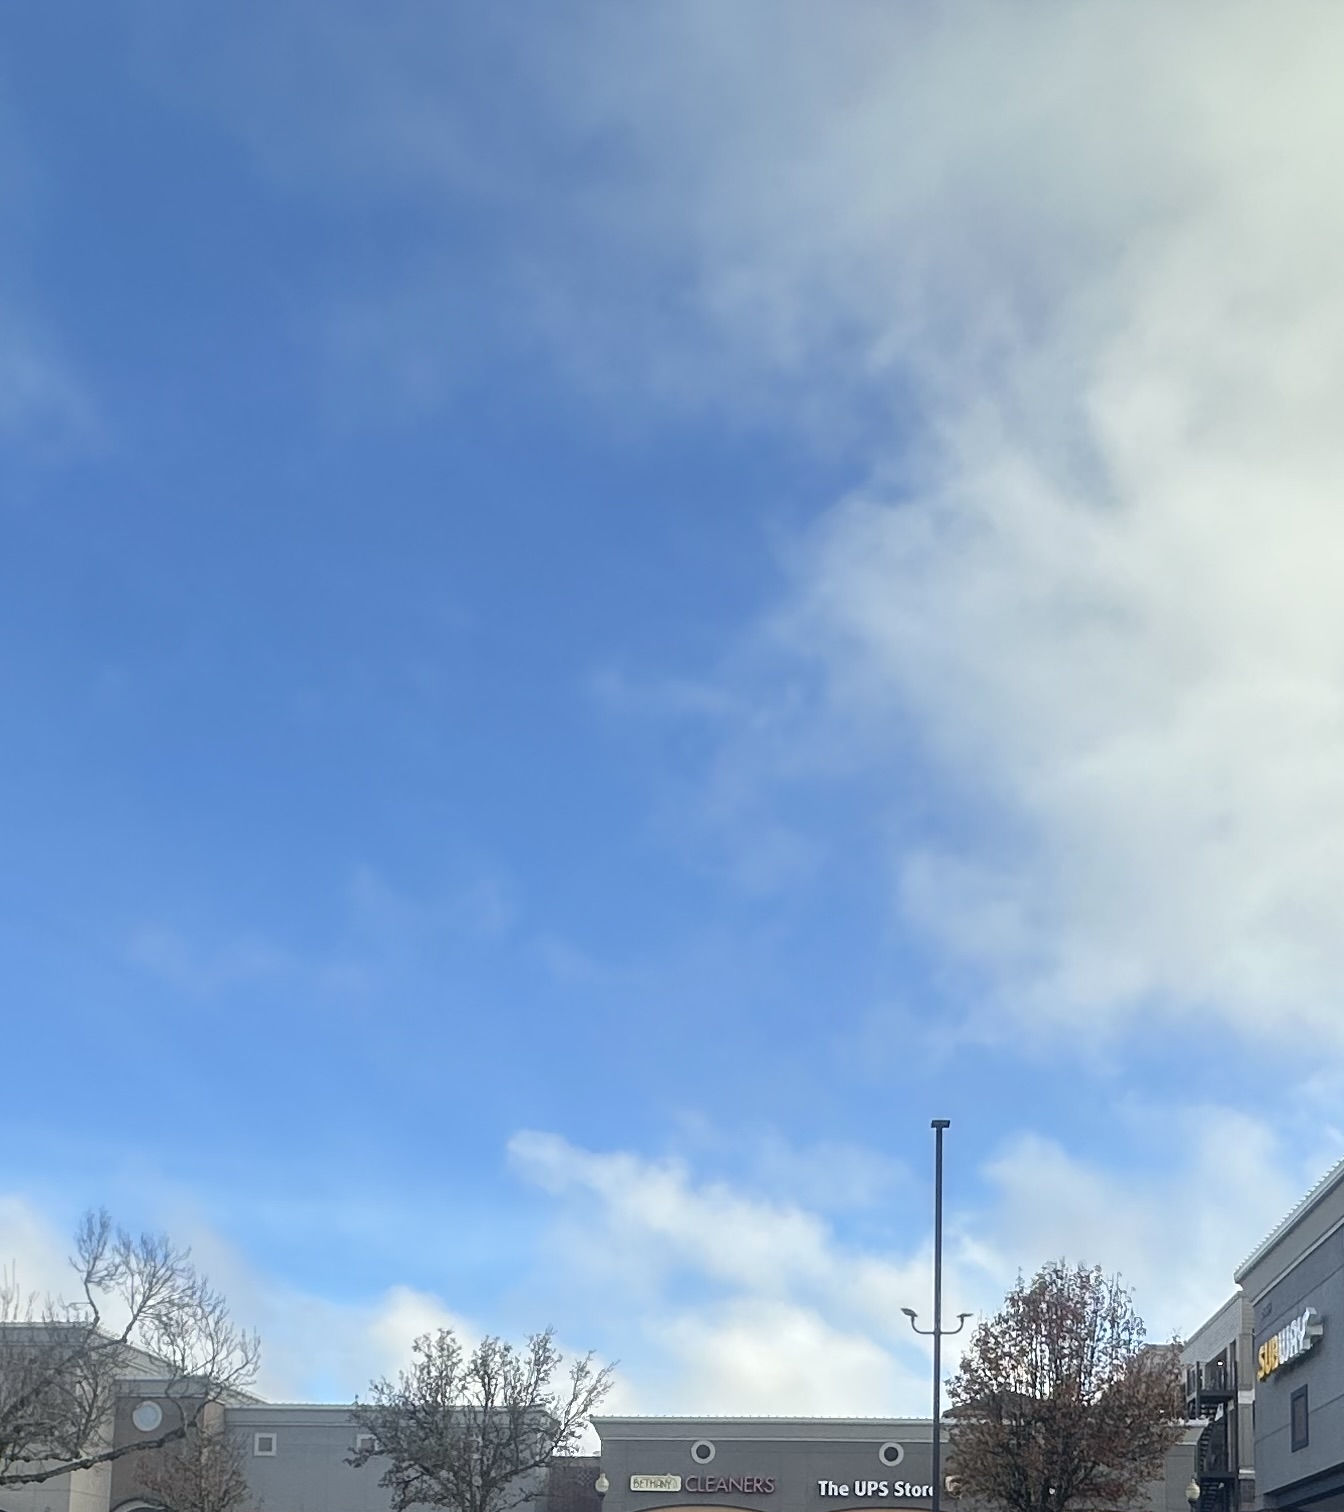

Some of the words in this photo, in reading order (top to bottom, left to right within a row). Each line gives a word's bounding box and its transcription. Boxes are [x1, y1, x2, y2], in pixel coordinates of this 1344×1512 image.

[1256, 1307, 1317, 1383] SUBWAY
[685, 1475, 775, 1493] CLEANERS
[817, 1480, 849, 1496] The
[854, 1480, 889, 1497] UPS
